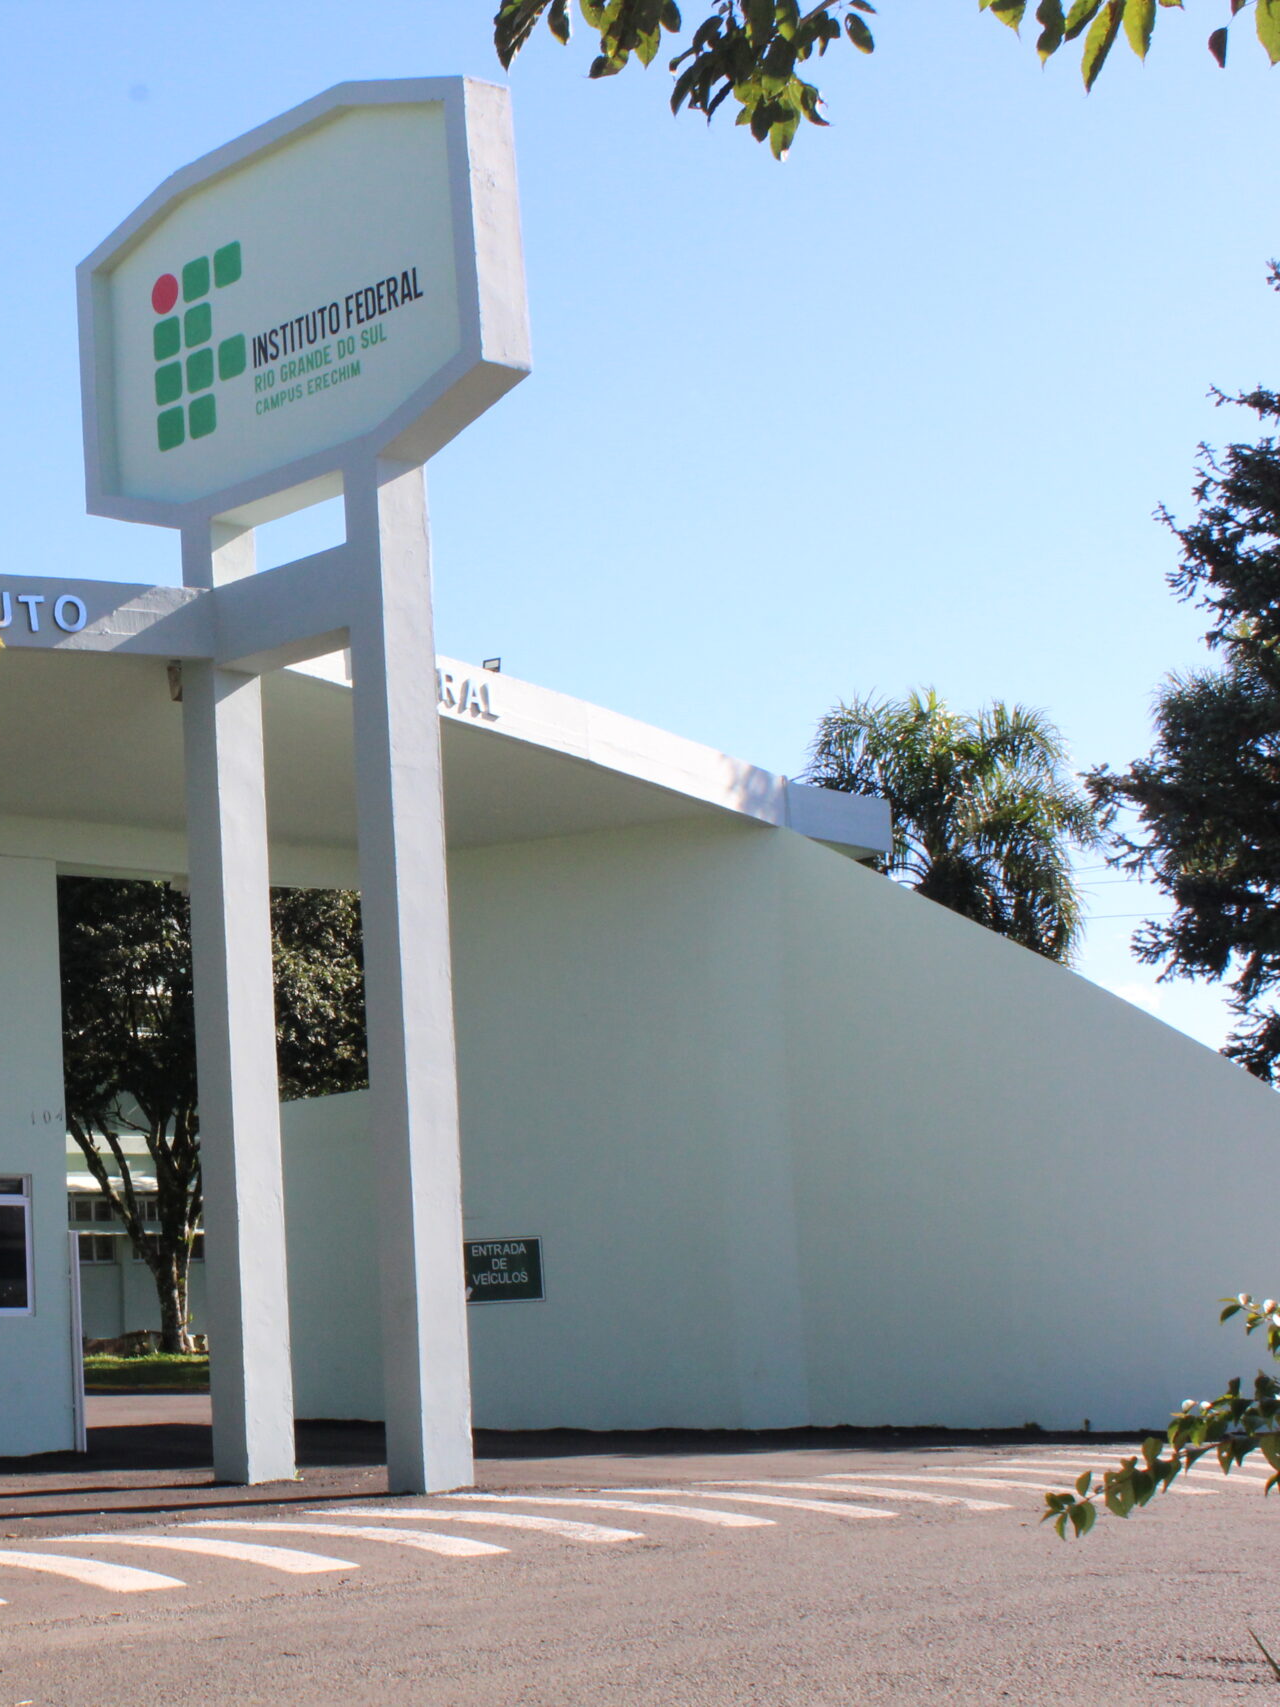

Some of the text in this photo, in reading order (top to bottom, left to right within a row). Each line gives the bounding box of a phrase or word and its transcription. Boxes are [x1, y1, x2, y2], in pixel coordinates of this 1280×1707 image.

[252, 266, 424, 368] INSTITUTO FEDERAL
[254, 322, 387, 393] RIO GRANDE DO SUL
[255, 359, 361, 415] CAMPUS ERECHIM
[471, 1243, 527, 1257] ENTRADA
[491, 1258, 508, 1270] DE
[472, 1271, 528, 1286] VEÍCULOS
